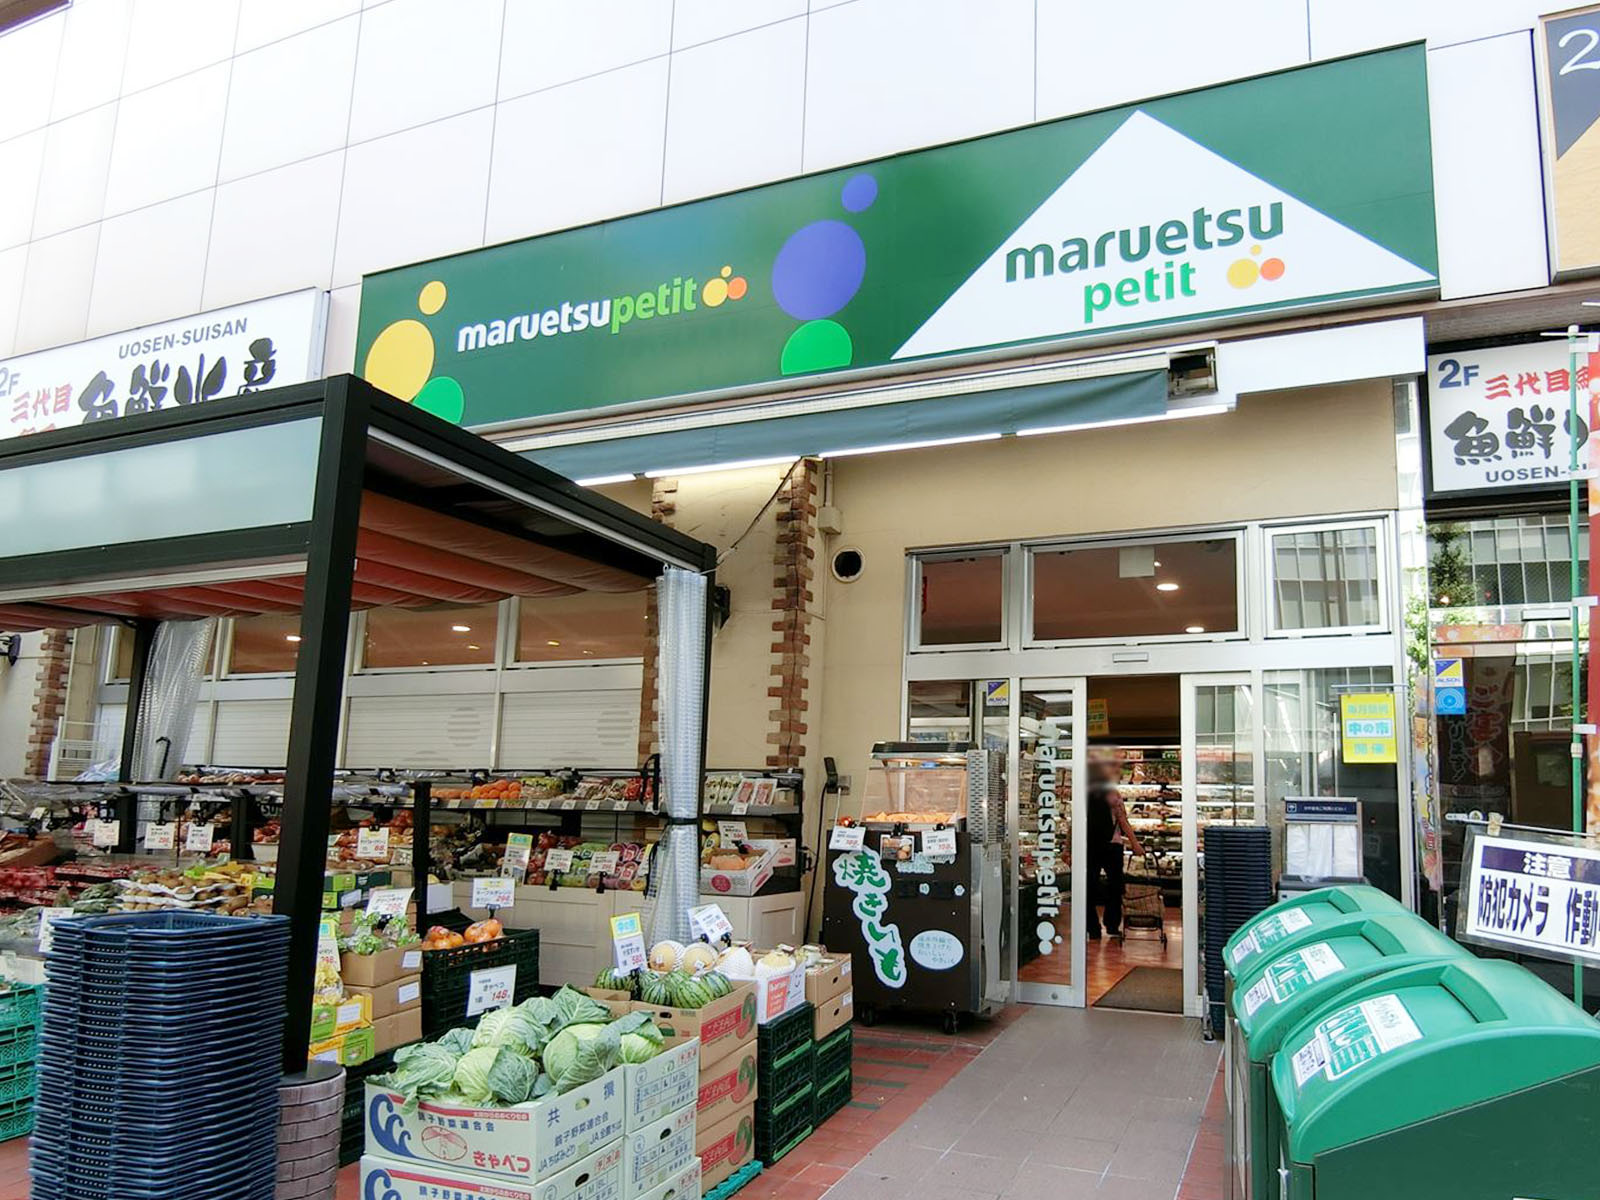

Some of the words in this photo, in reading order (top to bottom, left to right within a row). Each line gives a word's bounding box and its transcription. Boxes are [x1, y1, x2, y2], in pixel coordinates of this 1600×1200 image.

[1006, 202, 1283, 283] maruetsu
[1084, 260, 1196, 324] petit
[118, 318, 248, 360] UOSEN-SUISAN
[1438, 359, 1479, 389] 2F
[11, 384, 73, 424] 三代目
[1486, 463, 1588, 483] UOSEN-
[1523, 852, 1572, 879] 注意
[838, 851, 901, 981] 焼きいも
[1477, 875, 1549, 937] 防犯カメラ
[1566, 887, 1600, 947] 作動
[473, 1150, 531, 1173] きゃべつ
